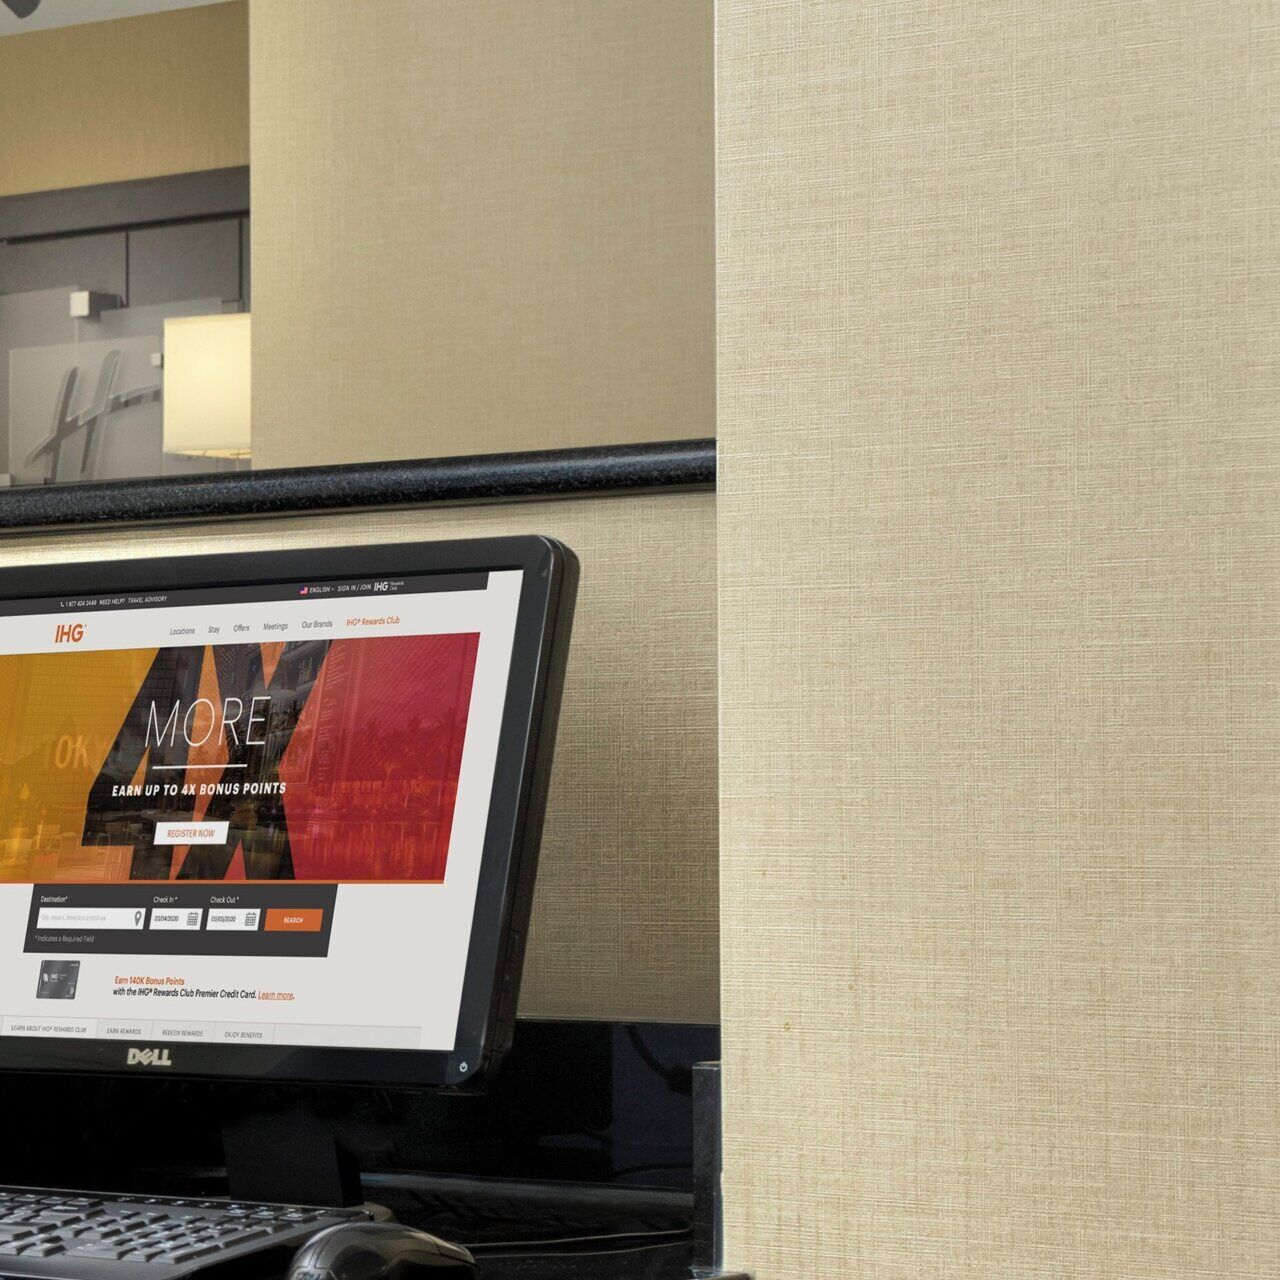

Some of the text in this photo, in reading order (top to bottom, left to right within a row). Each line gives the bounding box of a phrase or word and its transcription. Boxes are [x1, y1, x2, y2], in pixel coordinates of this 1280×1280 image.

[309, 586, 331, 594] ENGLISH
[374, 581, 389, 592] IHG
[55, 623, 84, 643] IHG
[170, 627, 195, 636] Locations
[208, 625, 220, 635] Stay
[233, 624, 250, 633] Offers
[263, 622, 288, 631] Meetings
[313, 619, 333, 628] Brands
[361, 617, 385, 625] Rewards
[386, 616, 400, 624] Club
[145, 696, 272, 748] MORE
[111, 782, 287, 797] EARN UP TO 4X BONUS POINTS
[167, 828, 216, 838] REGISTER NOW
[153, 896, 170, 904] Check
[209, 896, 226, 904] Check
[114, 976, 185, 986] Earn 140K Bonus Points
[113, 987, 126, 996] with
[126, 987, 137, 996] the
[153, 988, 179, 997] Rewards
[179, 988, 195, 997] Club
[195, 989, 219, 998] Premier
[219, 989, 240, 998] Credit
[239, 989, 257, 999] Card.
[258, 990, 276, 1000] Learn
[26, 1024, 41, 1032] ABOUT
[240, 1031, 263, 1039] BENEFITS
[127, 1048, 172, 1066] DELL
